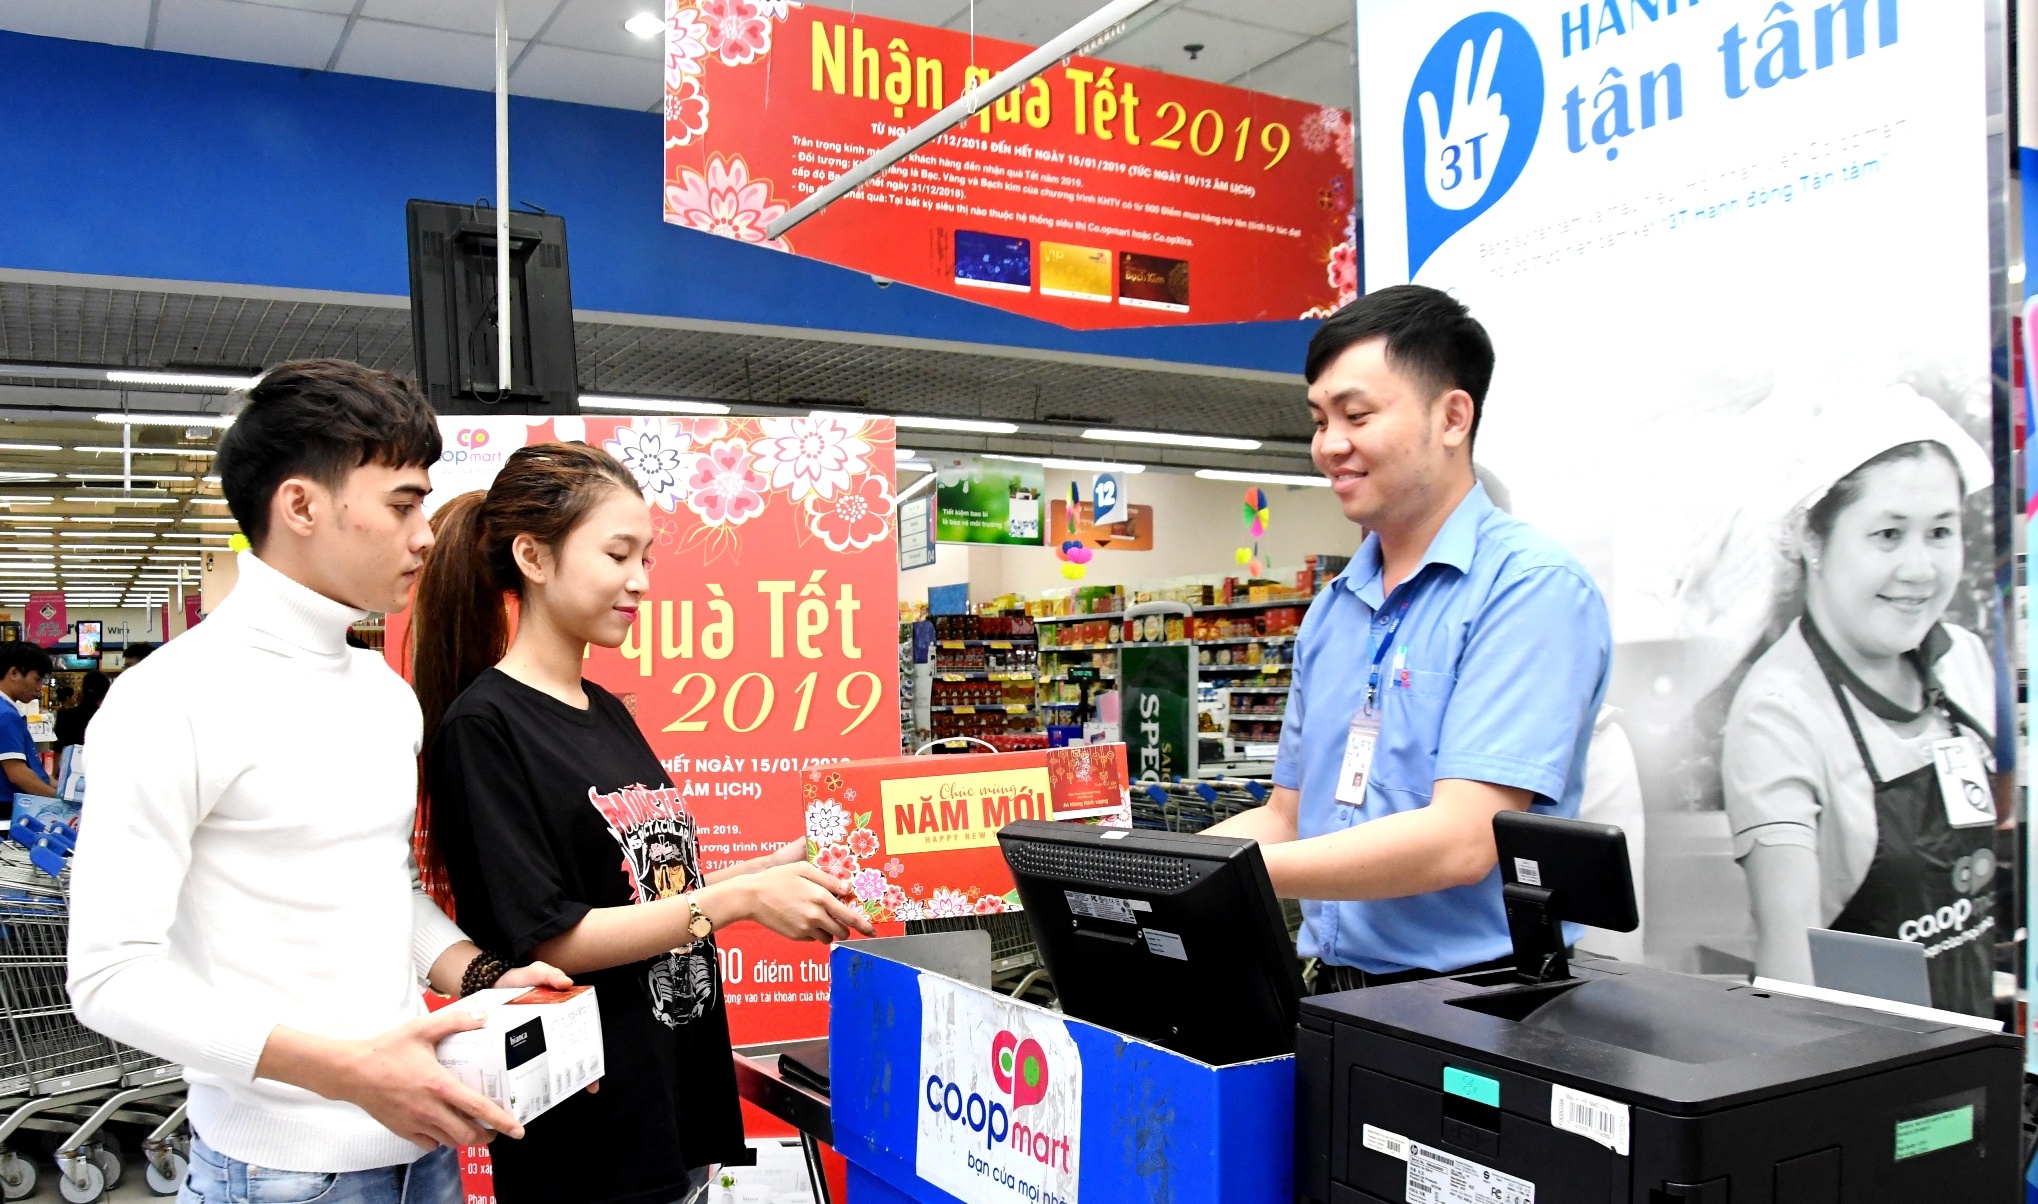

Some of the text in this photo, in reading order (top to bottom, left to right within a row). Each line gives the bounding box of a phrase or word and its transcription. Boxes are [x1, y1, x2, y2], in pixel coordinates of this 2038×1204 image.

[811, 20, 944, 118] Nhận
[1065, 66, 1141, 147] Tết
[1149, 100, 1292, 172] 2019
[1561, 0, 1898, 162] tận tâm
[792, 134, 815, 147] Trân
[815, 137, 842, 153] trọng
[843, 141, 866, 155] kính
[908, 153, 937, 167] khách
[938, 156, 963, 172] hàng
[963, 158, 981, 173] đến
[982, 162, 1006, 178] nhận
[1006, 167, 1024, 180] quà
[1024, 170, 1040, 182] Tết
[798, 151, 816, 163] Đối
[910, 166, 920, 178] là
[942, 173, 967, 186] Vàng
[967, 175, 980, 187] và
[980, 177, 1004, 191] Bạch
[870, 121, 885, 136] TỪ
[990, 139, 1012, 155] ĐẾN
[1013, 143, 1033, 159] HẾT
[1034, 149, 1065, 164] NGÀY
[1067, 153, 1127, 174] 15/01/2019
[1153, 169, 1182, 184] NGÀY
[1440, 132, 1490, 191] 3T
[791, 167, 811, 183] cấp
[812, 170, 826, 182] độ
[886, 180, 910, 194] ngày
[798, 182, 815, 195] Địa
[888, 194, 904, 207] Tại
[904, 193, 921, 207] bất
[933, 199, 955, 213] siêu
[955, 203, 970, 217] thị
[970, 205, 988, 217] nào
[1015, 212, 1028, 224] hệ
[1095, 480, 1116, 508] 12
[620, 569, 862, 677] quà Tết
[661, 671, 883, 737] 2019
[661, 753, 691, 773] HẾT
[695, 755, 746, 773] NGÀY
[682, 779, 763, 800] ÂM LỊCH)
[940, 781, 976, 800] Chúc
[712, 824, 742, 836] 2019.
[894, 786, 1047, 836] NĂM MỚI
[733, 840, 760, 852] trình
[925, 834, 959, 844] HAPPY
[964, 831, 987, 841] NEW
[753, 959, 793, 984] điểm
[509, 1031, 528, 1047] bianca
[926, 1074, 1070, 1175] co.op mart
[467, 1162, 478, 1175] 03
[967, 1150, 990, 1177] bạn
[992, 1167, 1015, 1190] của
[1018, 1179, 1041, 1204] mọi
